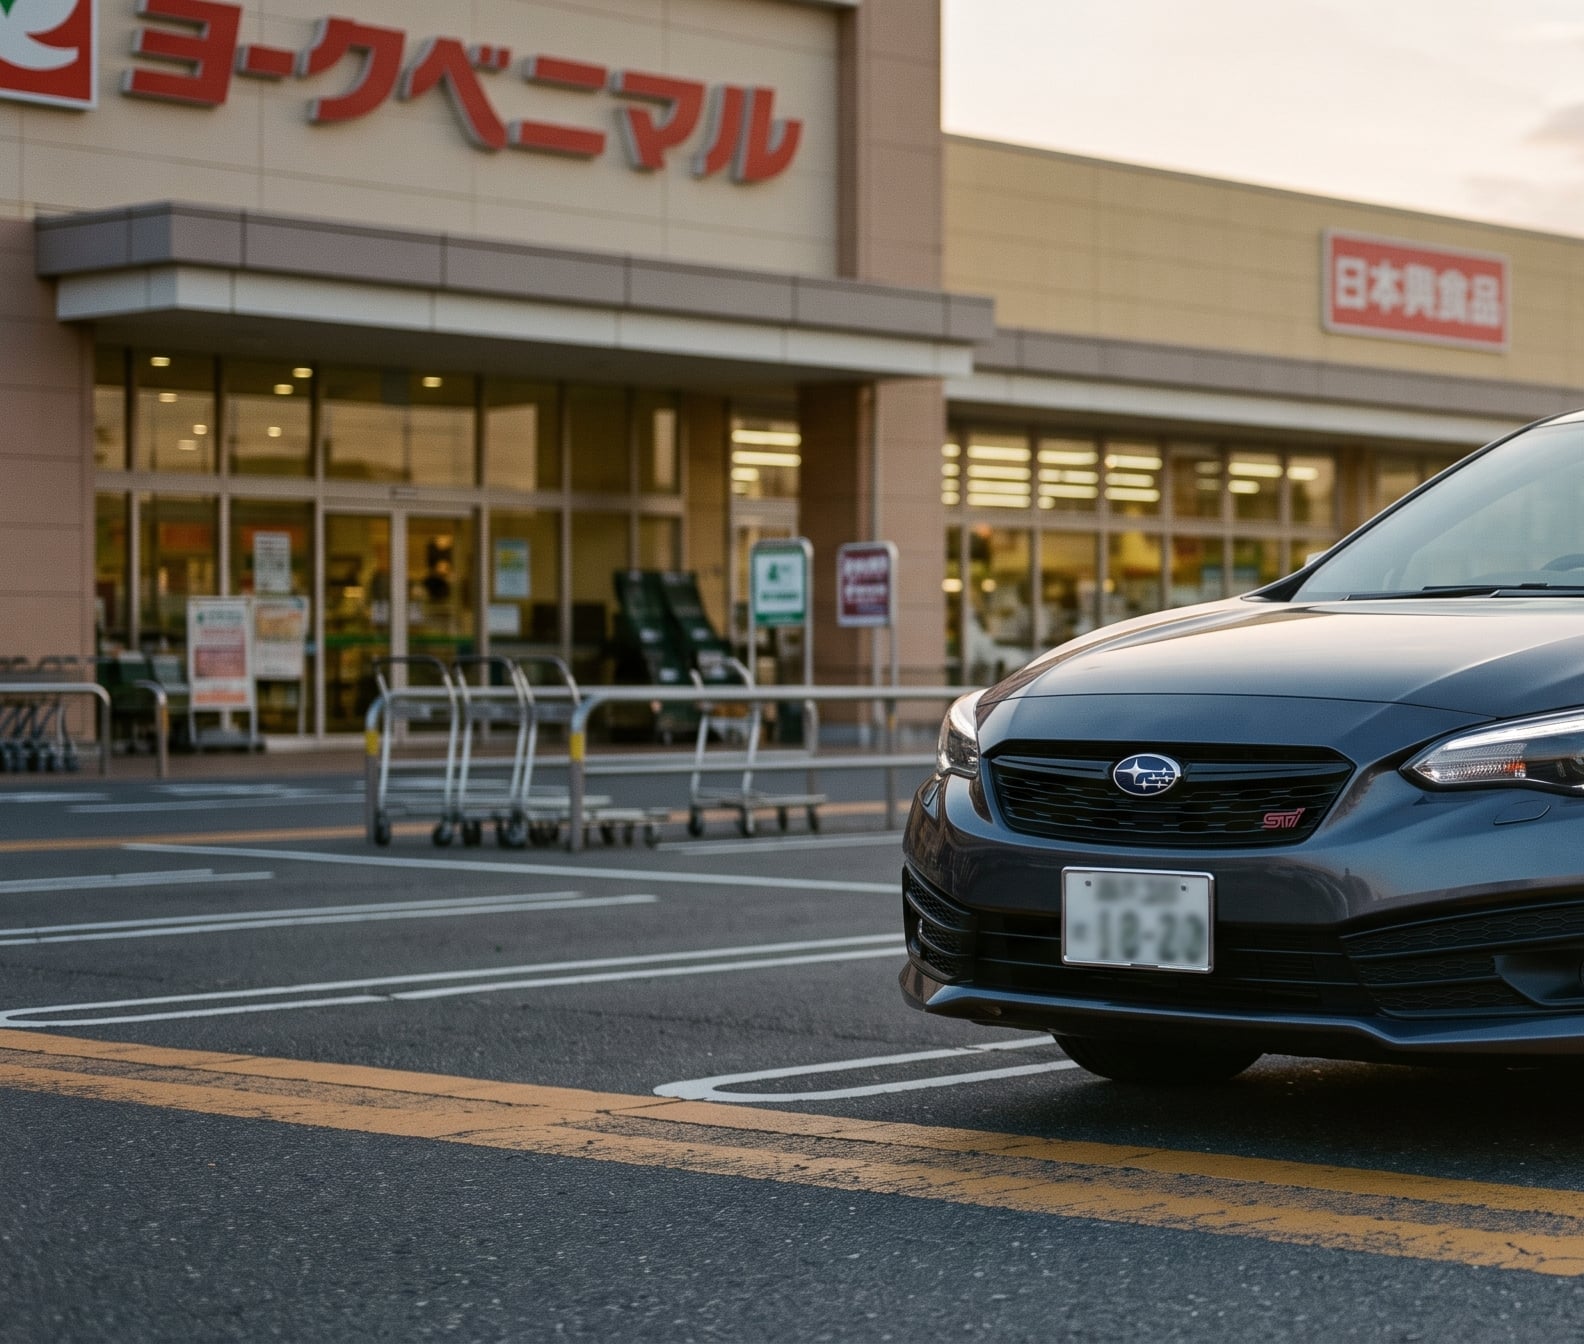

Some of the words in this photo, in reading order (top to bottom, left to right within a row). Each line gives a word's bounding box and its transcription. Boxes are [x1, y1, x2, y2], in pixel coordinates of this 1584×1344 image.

[120, 0, 806, 184] ヨークベニマル
